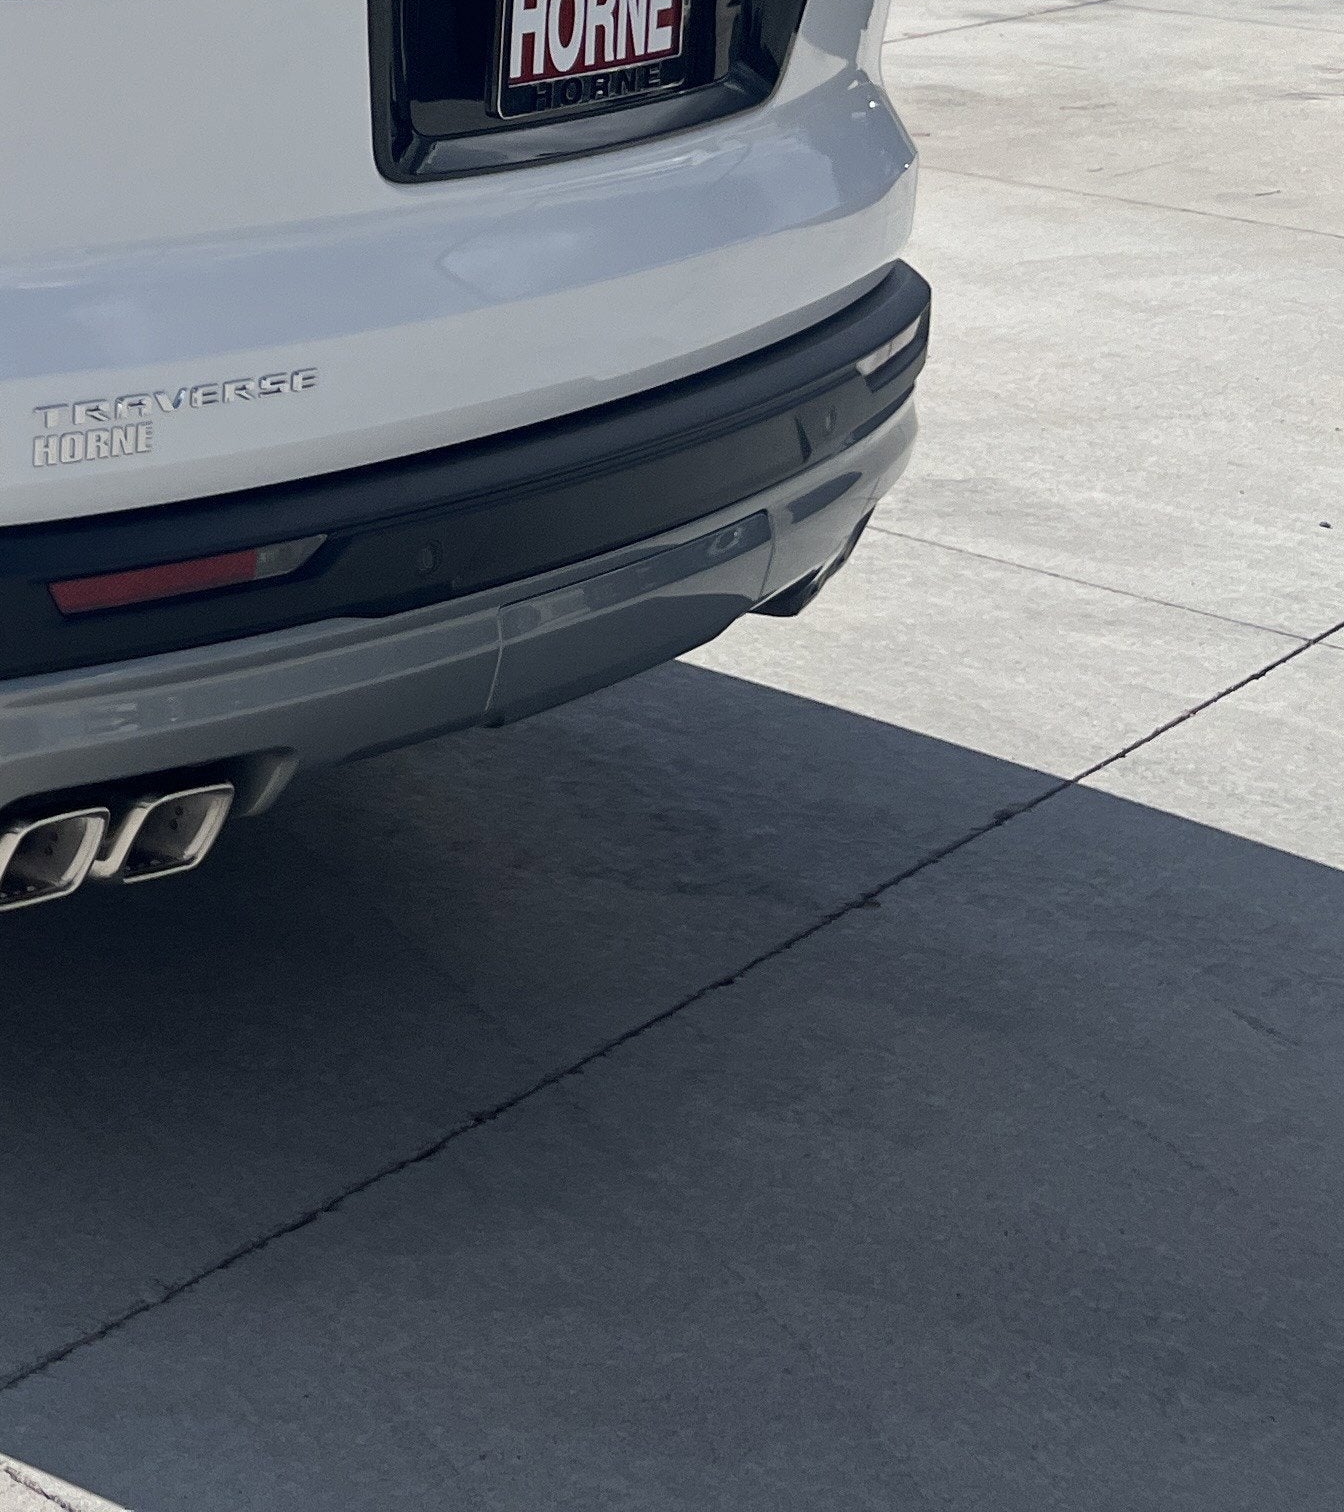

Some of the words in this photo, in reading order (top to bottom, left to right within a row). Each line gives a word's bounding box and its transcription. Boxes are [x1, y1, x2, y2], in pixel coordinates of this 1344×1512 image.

[535, 66, 661, 111] HORNE
[33, 367, 318, 429] TRAVERSE
[32, 420, 154, 467] HORNE
